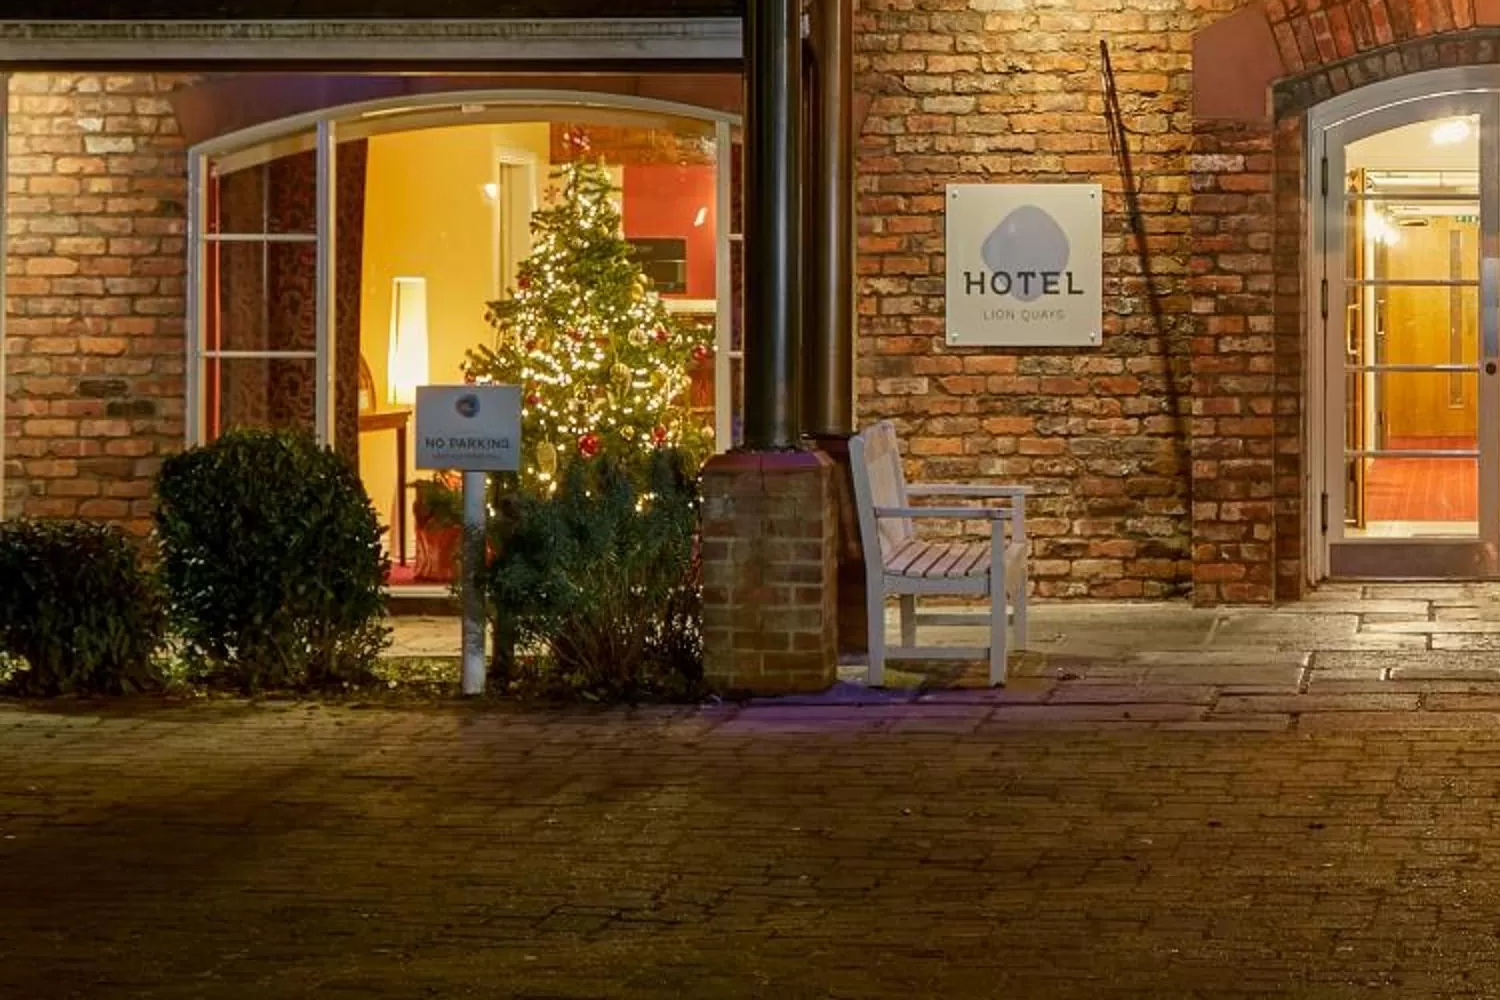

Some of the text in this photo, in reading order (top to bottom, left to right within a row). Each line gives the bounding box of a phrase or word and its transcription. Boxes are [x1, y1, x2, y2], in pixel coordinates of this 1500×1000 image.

[963, 271, 1085, 295] HOTEL
[983, 309, 1066, 322] LION QUAYS
[424, 437, 510, 449] NO PARKING
